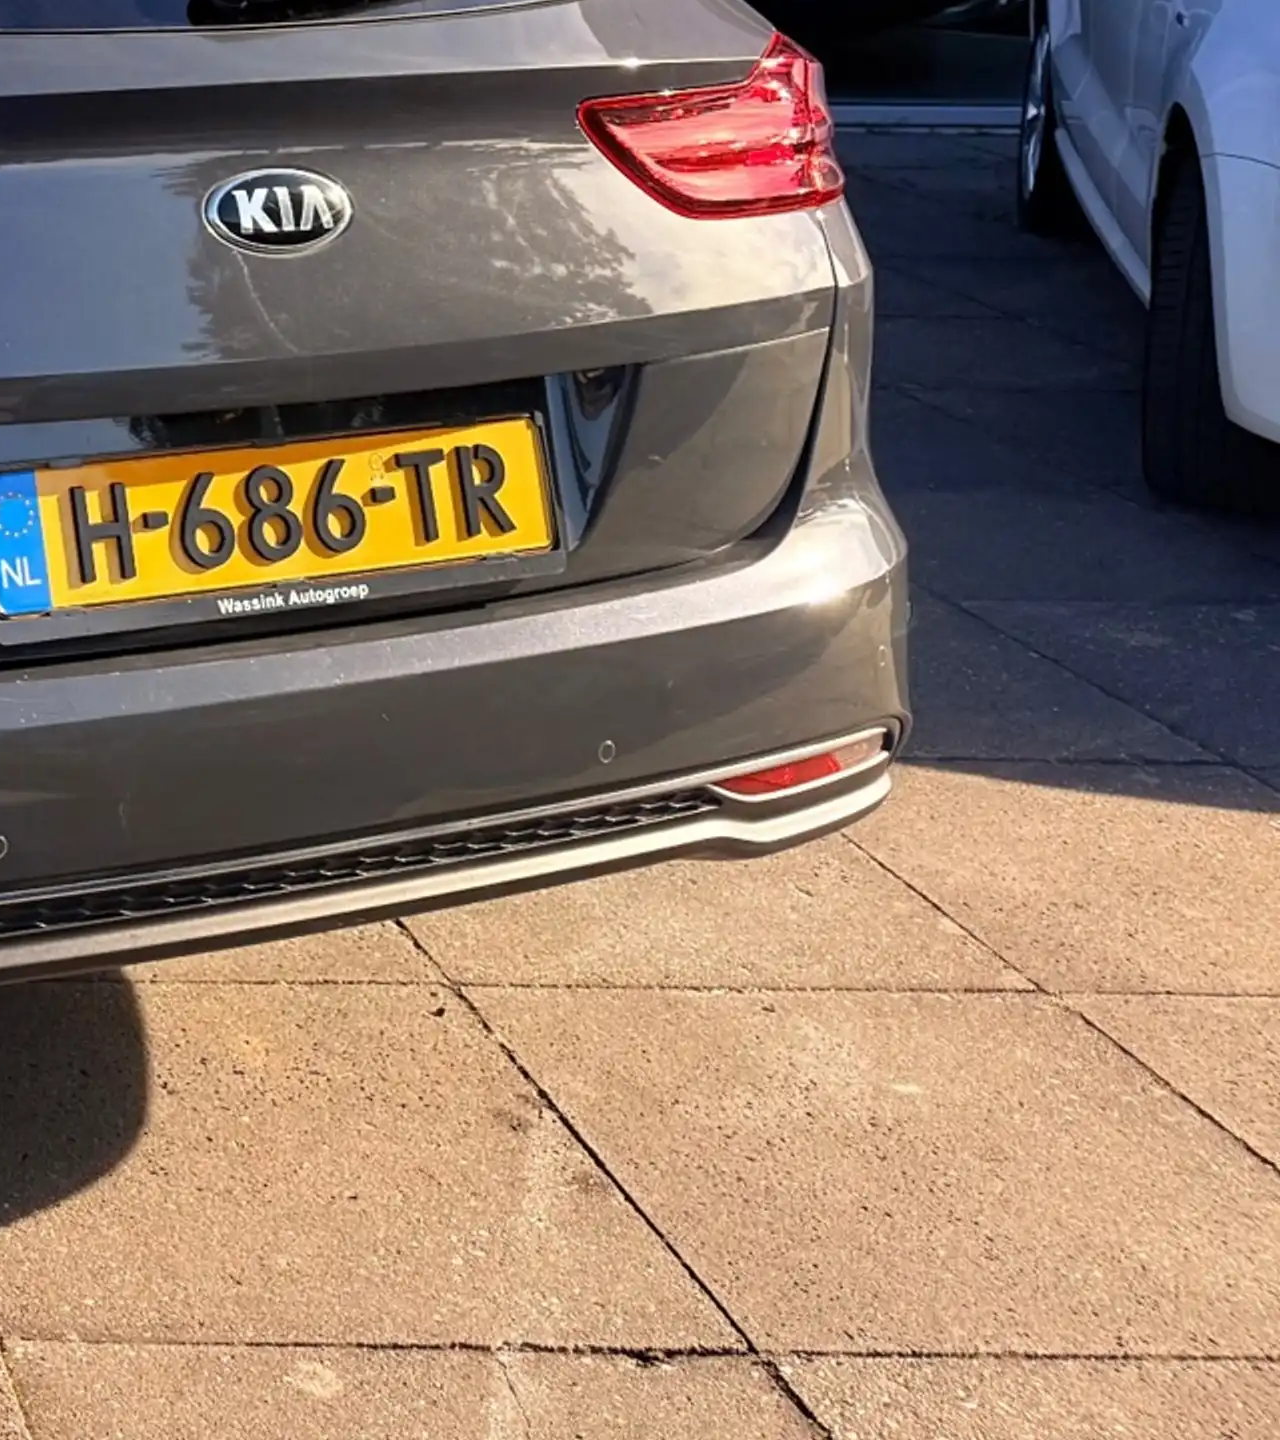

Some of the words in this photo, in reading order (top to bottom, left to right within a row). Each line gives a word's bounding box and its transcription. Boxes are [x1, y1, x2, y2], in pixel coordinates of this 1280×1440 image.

[231, 185, 335, 235] KIA
[67, 444, 518, 586] H-686-TR
[0, 559, 42, 588] NL
[217, 591, 285, 615] Wassink
[289, 583, 370, 605] Autogroep
